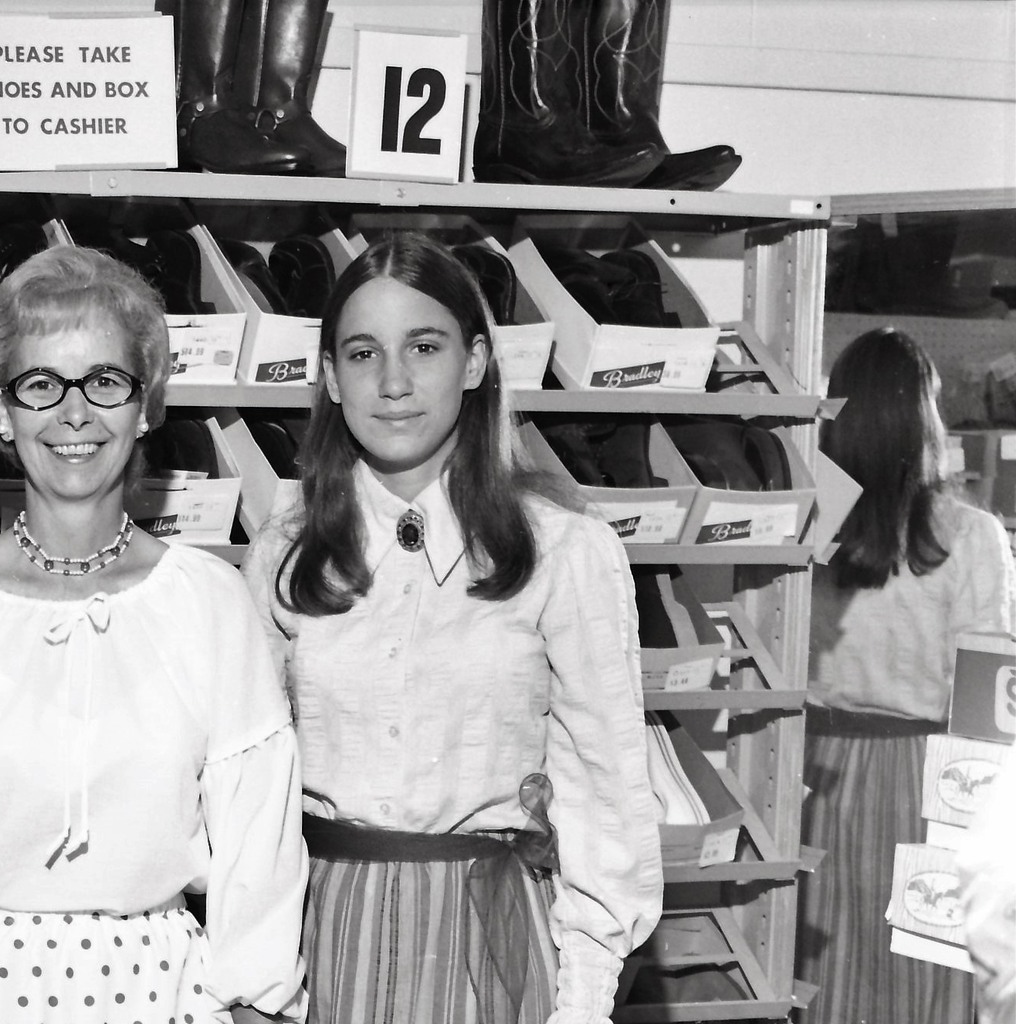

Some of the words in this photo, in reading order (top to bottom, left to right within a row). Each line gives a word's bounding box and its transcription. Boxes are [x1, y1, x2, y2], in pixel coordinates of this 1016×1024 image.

[79, 46, 131, 63] TAKE
[51, 81, 98, 98] AND
[105, 81, 149, 98] BOX
[380, 65, 447, 155] 12
[2, 117, 30, 135] TO
[40, 117, 128, 135] CASHIER
[603, 366, 664, 389] Bradley
